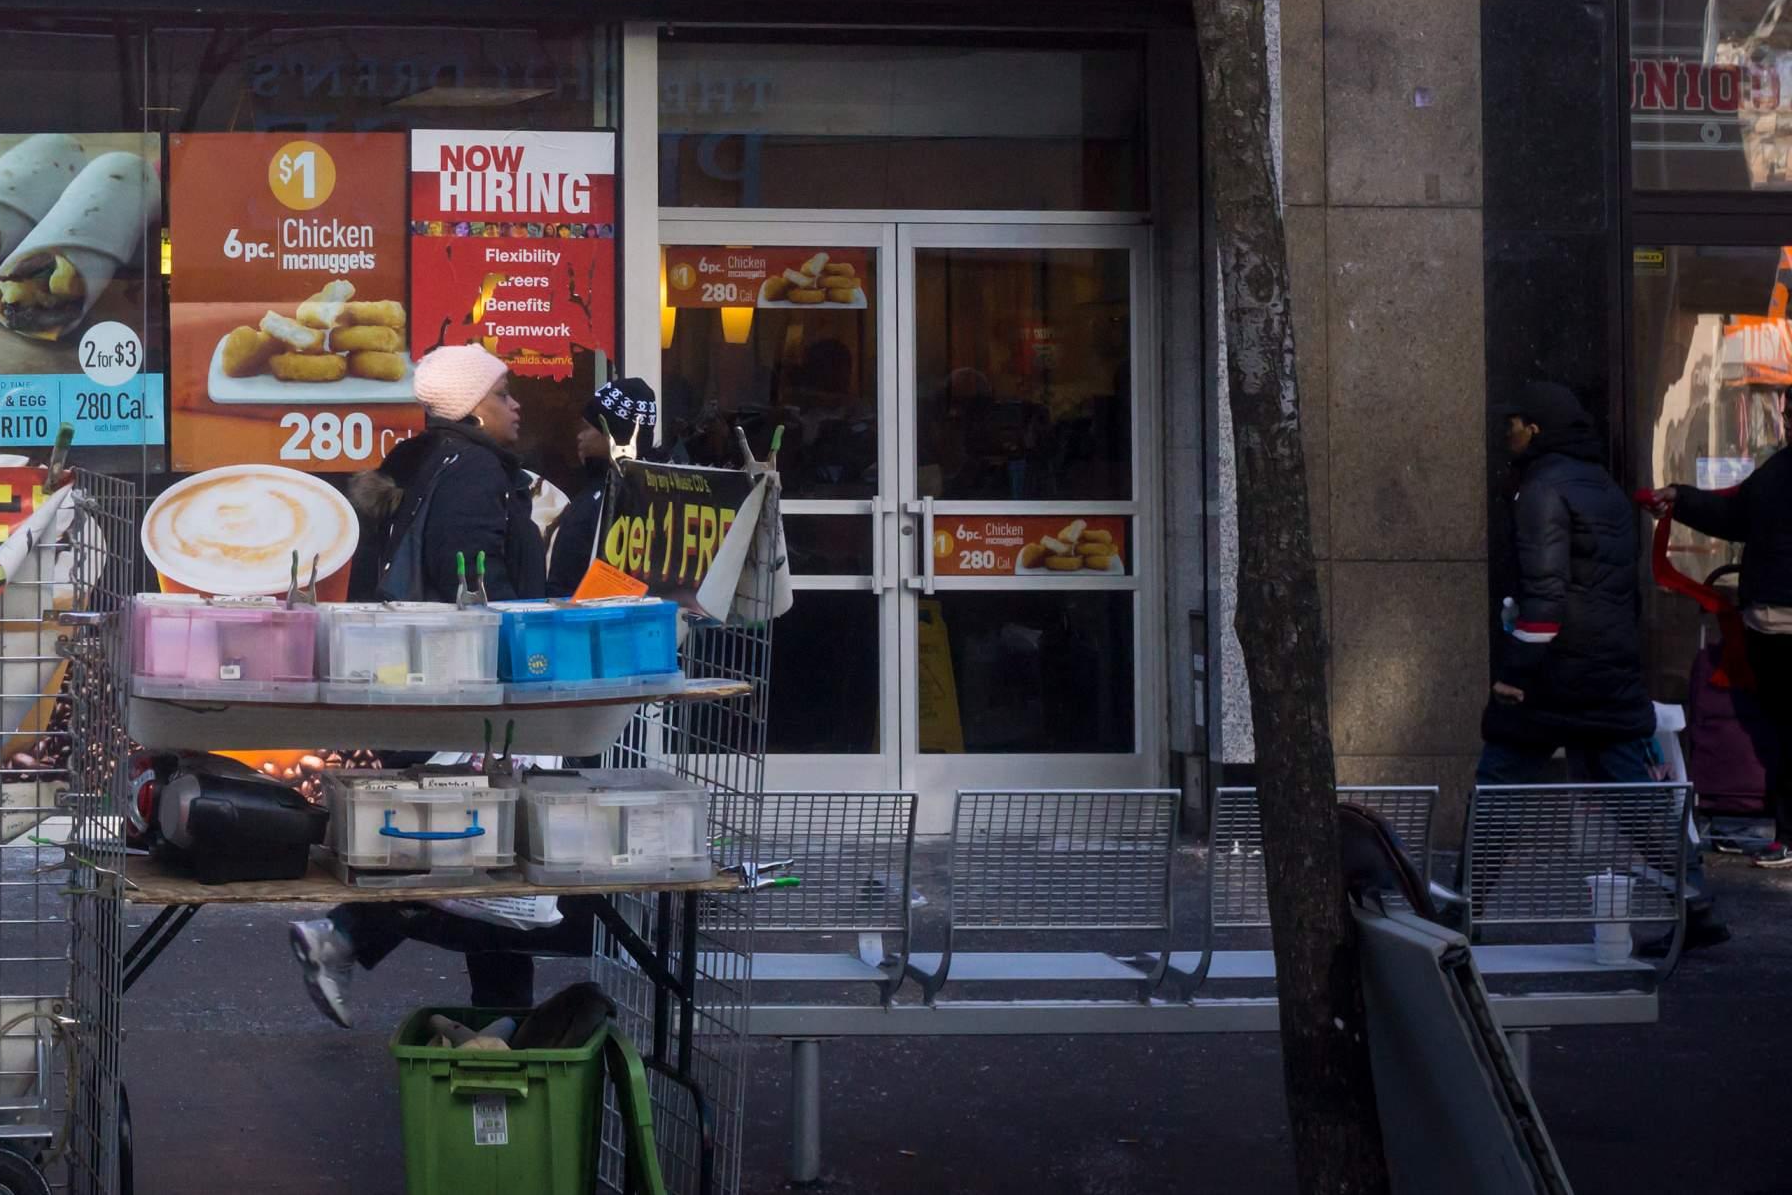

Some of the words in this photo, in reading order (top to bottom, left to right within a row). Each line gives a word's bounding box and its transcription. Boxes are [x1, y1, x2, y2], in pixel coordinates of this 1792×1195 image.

[440, 145, 524, 172] NOW
[279, 151, 316, 199] $1
[440, 171, 590, 214] HIRING
[283, 218, 373, 248] Chicken
[283, 251, 376, 274] mcnuggets
[485, 248, 560, 266] Flexibility
[728, 256, 766, 269] Chicken
[498, 276, 549, 287] areers
[702, 283, 737, 302] 280
[485, 298, 551, 312] Benefits
[485, 322, 570, 338] Teamwork
[84, 341, 96, 368] 2
[97, 350, 114, 368] for
[114, 340, 137, 368] $3
[6, 396, 15, 407] &
[19, 395, 47, 407] EGG
[76, 392, 112, 420] 280
[280, 412, 373, 460] 280
[985, 523, 1023, 536] Chicken
[605, 502, 655, 572] get
[664, 502, 674, 576] 1
[679, 504, 736, 582] FRE
[959, 550, 995, 569] 280
